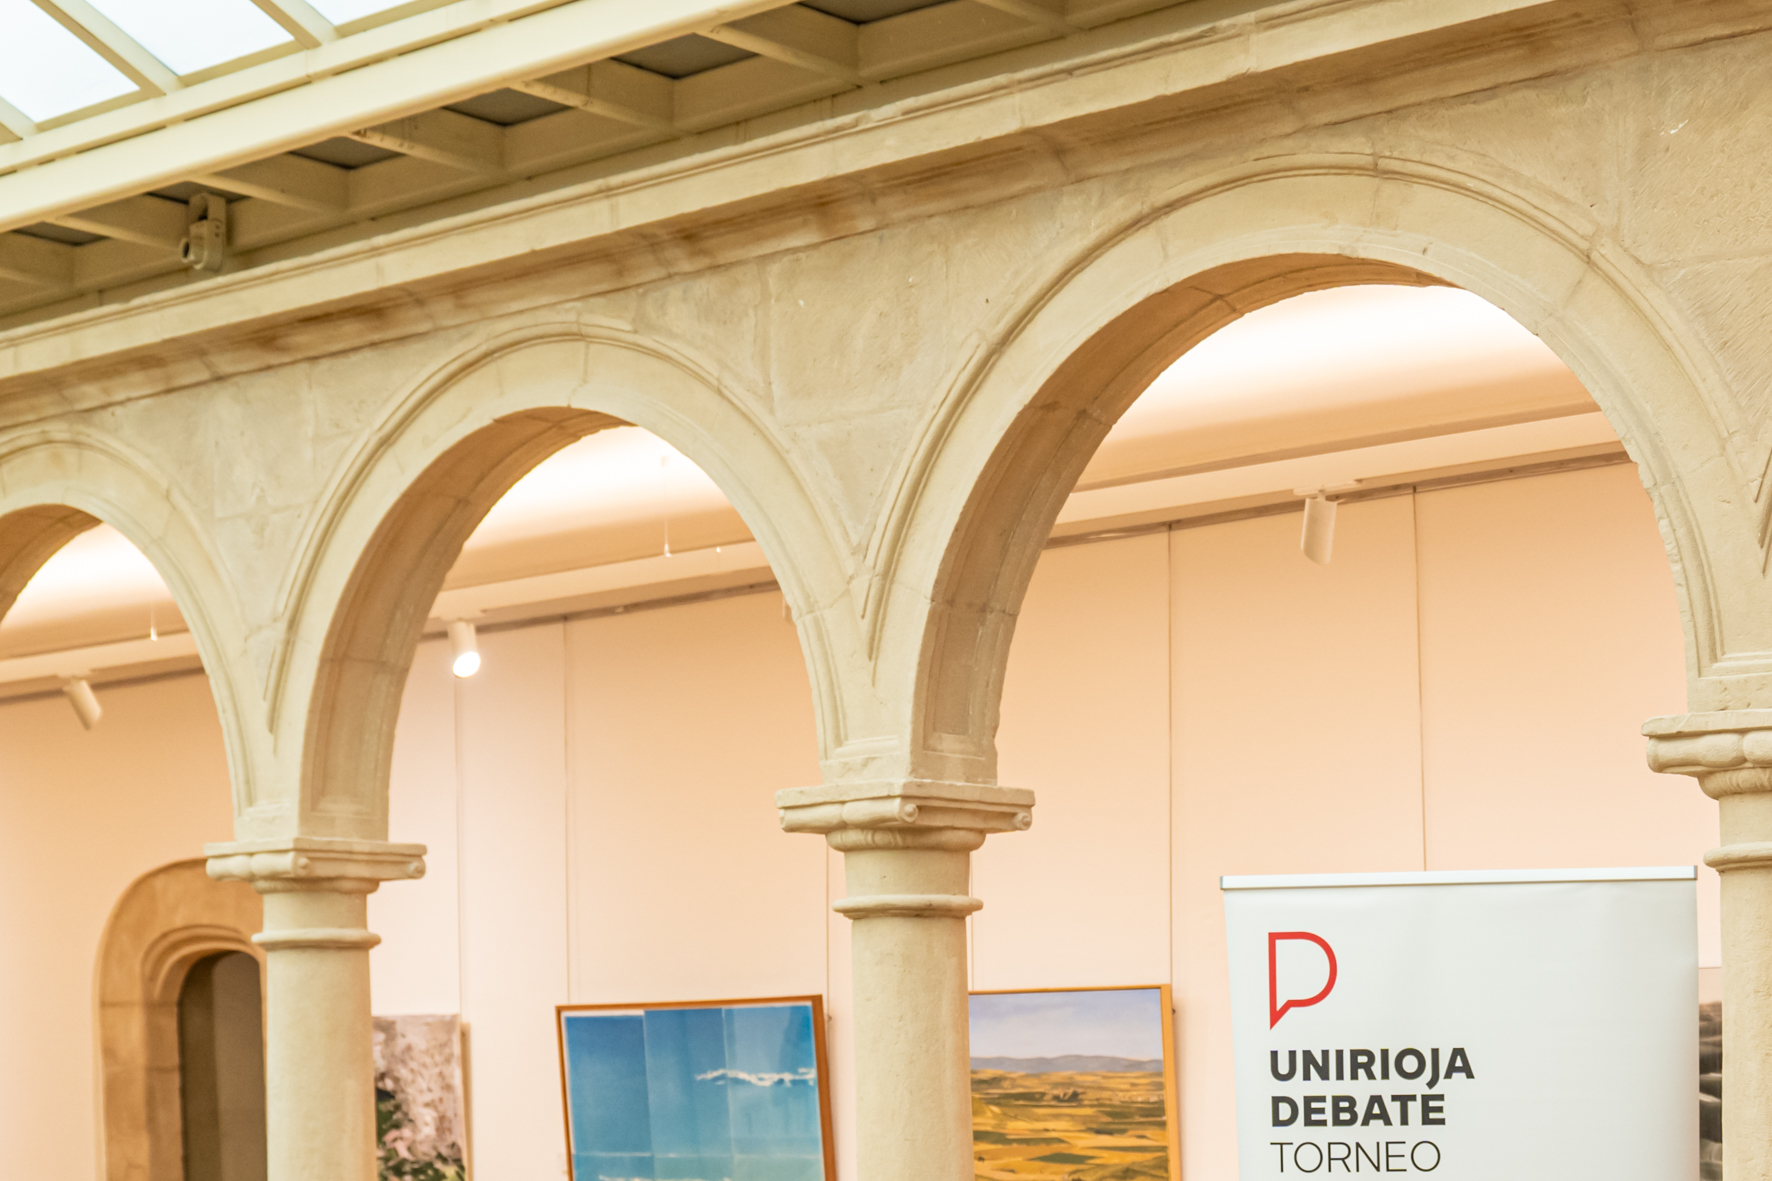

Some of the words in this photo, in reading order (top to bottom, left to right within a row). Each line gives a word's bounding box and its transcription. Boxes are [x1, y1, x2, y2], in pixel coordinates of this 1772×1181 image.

[1270, 1047, 1475, 1090] UNIRIOJA
[1271, 1094, 1446, 1127] DEBATE
[1270, 1140, 1441, 1173] TORNEO
